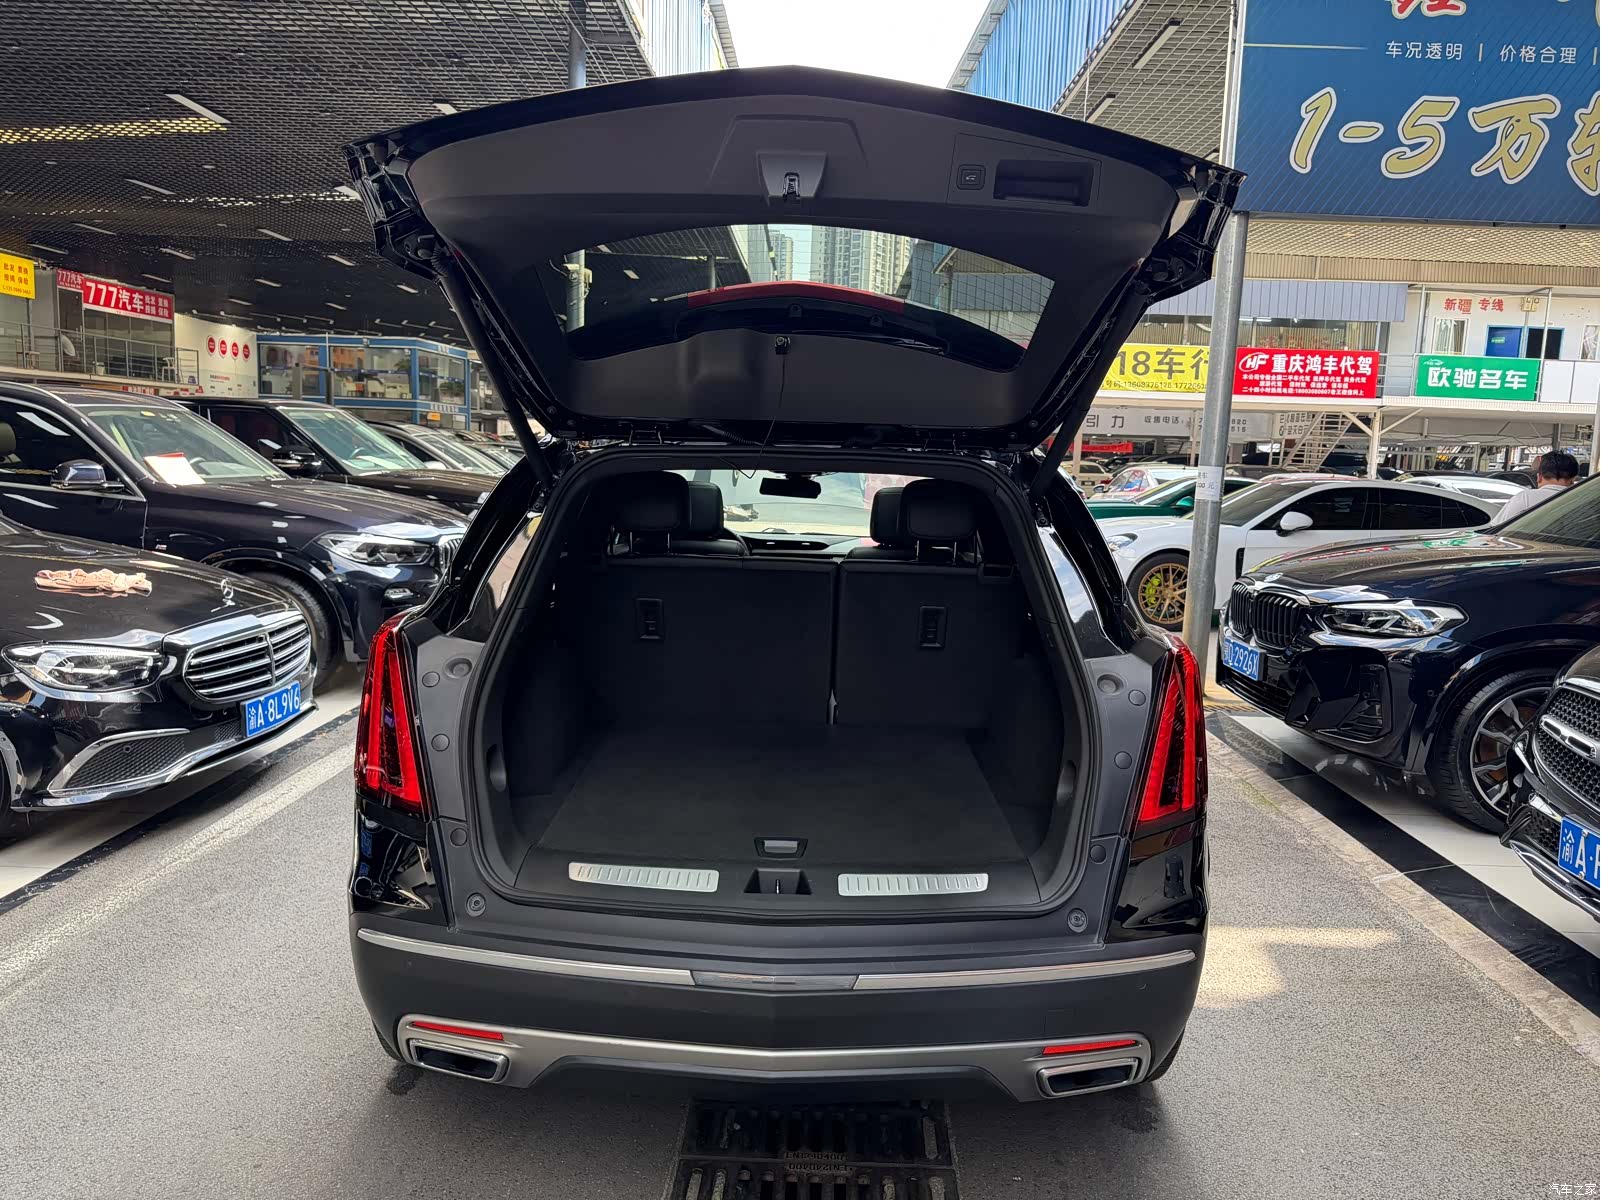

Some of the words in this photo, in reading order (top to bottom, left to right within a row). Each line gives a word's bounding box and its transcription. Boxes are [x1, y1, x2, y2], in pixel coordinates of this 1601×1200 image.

[1385, 41, 1463, 61] 车况透明
[1499, 45, 1577, 65] 价格合理
[58, 269, 82, 285] 777汽车
[86, 281, 144, 312] 777汽车
[1444, 297, 1473, 315] 新疆
[1478, 298, 1504, 313] 专线
[1271, 353, 1373, 376] 重庆鸿丰代驾
[1427, 366, 1529, 390] 欧驰名车
